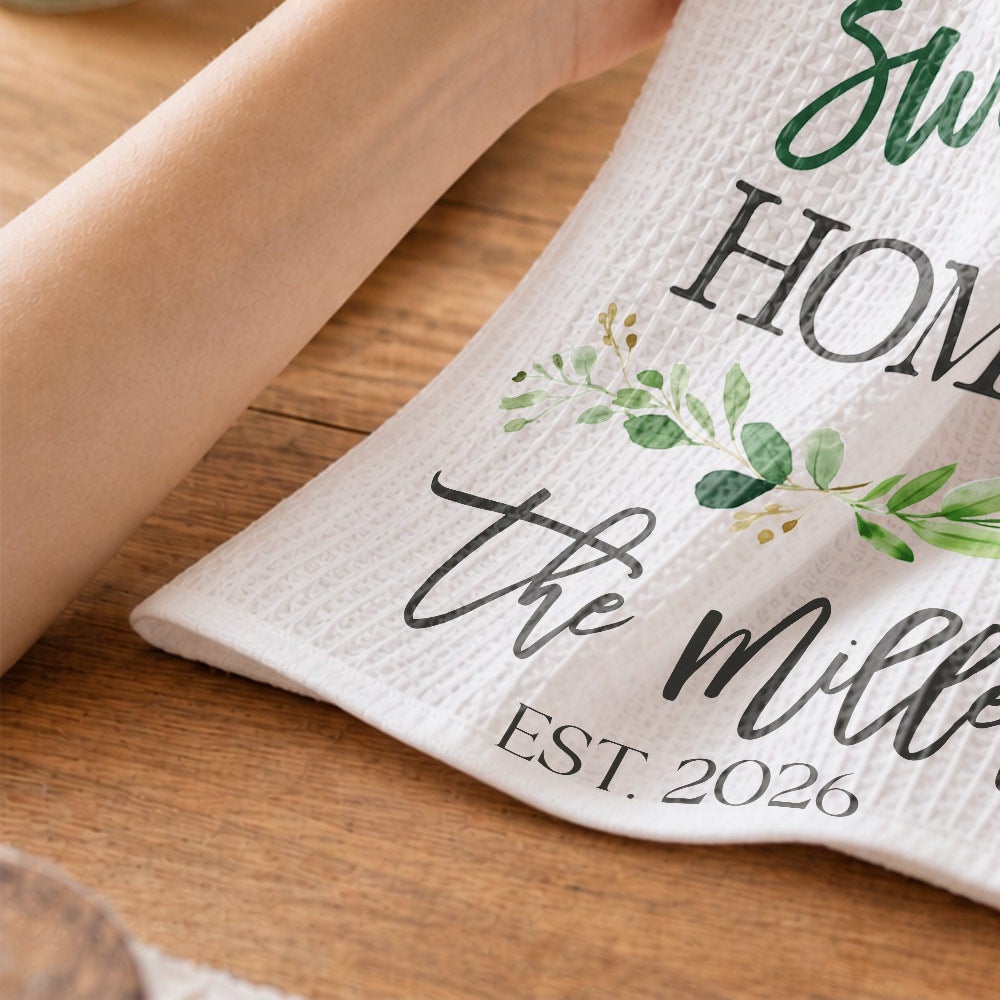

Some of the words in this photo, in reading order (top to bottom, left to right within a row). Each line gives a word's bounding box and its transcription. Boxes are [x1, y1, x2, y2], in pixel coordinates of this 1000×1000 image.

[403, 470, 657, 660] the
[495, 703, 649, 800] EST.
[662, 758, 860, 818] 2026
